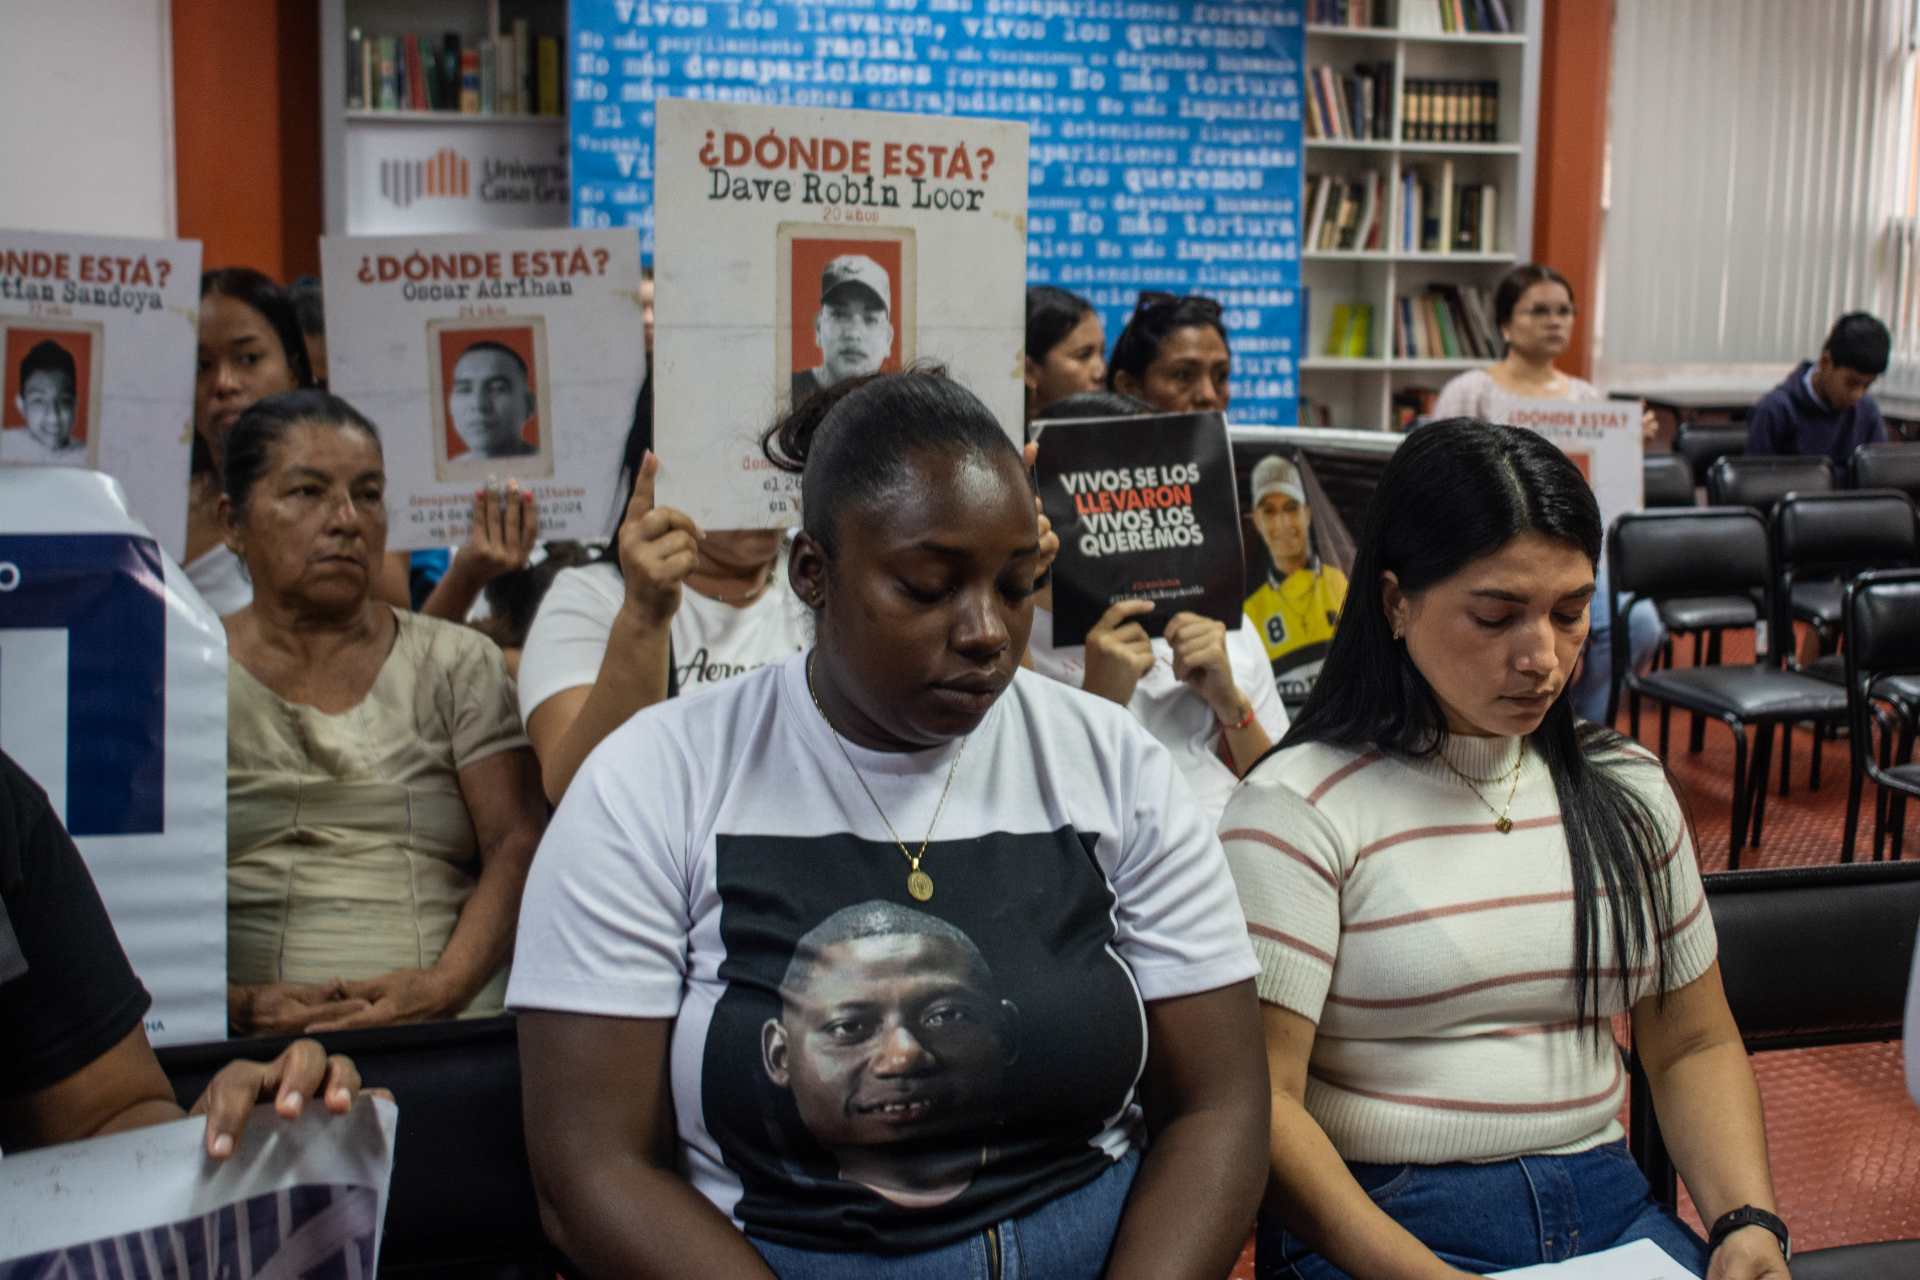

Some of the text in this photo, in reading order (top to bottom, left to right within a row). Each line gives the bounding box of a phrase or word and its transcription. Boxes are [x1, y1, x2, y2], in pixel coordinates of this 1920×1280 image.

[614, 0, 1267, 50] Vivos los llevaron, vivos los queremos
[814, 34, 918, 62] racial
[577, 50, 1299, 97] No más desapariciones forzadas No más tortura
[574, 77, 608, 101] No
[620, 76, 670, 102] más
[1096, 96, 1124, 116] No
[1178, 97, 1300, 122] impunidad
[1029, 117, 1052, 138] ás
[699, 128, 872, 176] ¿DÓNDE
[883, 141, 995, 182] ESTÁ?
[1029, 142, 1178, 166] apariciones
[1189, 146, 1296, 167] forzadas
[708, 167, 985, 211] Dave Robin Loor
[1062, 163, 1110, 188] los
[1122, 167, 1263, 193] queremos
[578, 207, 611, 229] No
[624, 204, 655, 229] má
[1068, 211, 1103, 235] No
[1117, 207, 1168, 235] más
[1184, 214, 1295, 237] tortura
[823, 206, 880, 222] 20 años
[1095, 239, 1123, 259] No
[1131, 236, 1166, 259] más
[1177, 240, 1296, 263] impunidad
[3, 249, 172, 289] NDE ESTÁ?
[358, 246, 611, 284] ¿DÓNDE ESTÁ?
[1027, 262, 1050, 281] ás
[1, 276, 54, 301] tian
[62, 280, 164, 314] Sandoya
[402, 275, 574, 301] Oscar Adrihan
[1229, 336, 1292, 353] umanos
[1231, 355, 1293, 375] tura
[1228, 378, 1295, 400] nidad
[1228, 405, 1279, 424] gales
[763, 476, 779, 491] el
[1060, 463, 1200, 495] VIVOS SE LOS
[769, 501, 787, 512] en
[1075, 484, 1192, 515] LLEVARON
[1082, 505, 1195, 534] VIVOS LOS
[1080, 524, 1204, 557] QUEREMOS
